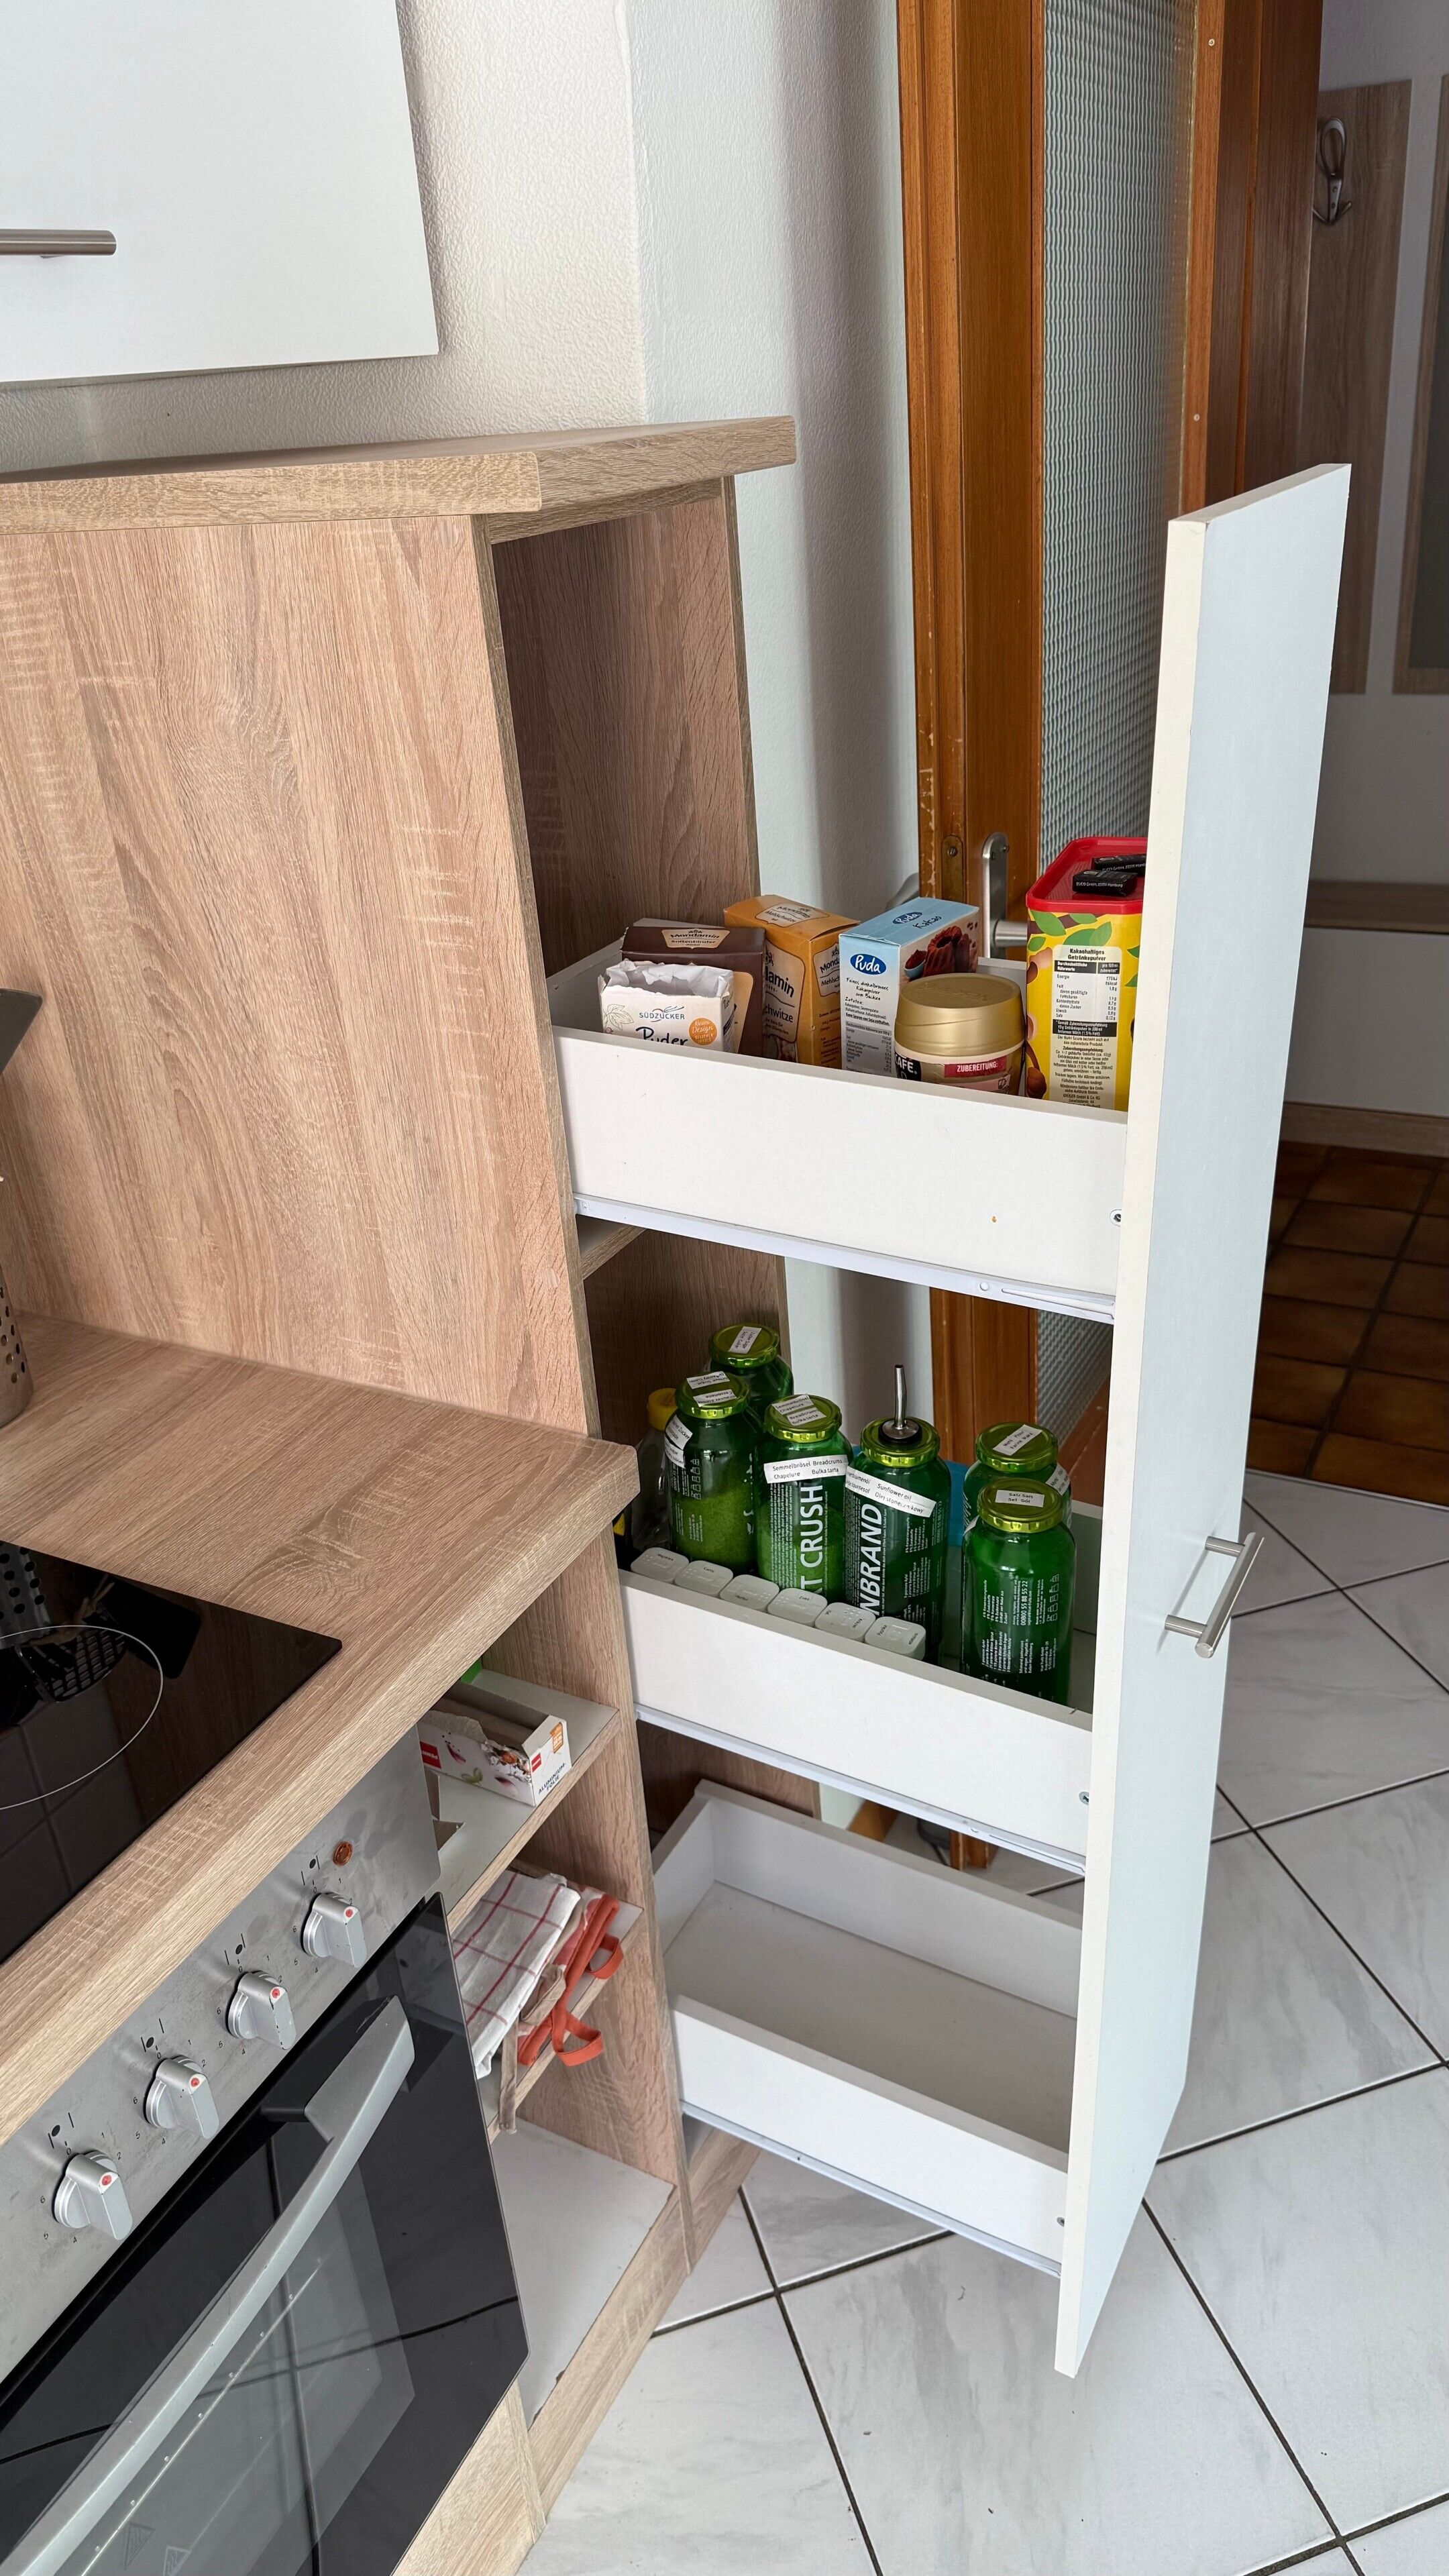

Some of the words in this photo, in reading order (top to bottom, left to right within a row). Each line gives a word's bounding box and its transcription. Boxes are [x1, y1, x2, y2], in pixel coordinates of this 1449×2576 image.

[896, 914, 918, 923] Puda
[913, 916, 942, 928] Kakao
[855, 955, 881, 973] Puda
[639, 1012, 684, 1020] SÜDZUCKER
[692, 1026, 714, 1034] Design
[957, 1061, 998, 1073] ZUBEREITUNG:
[773, 1461, 810, 1471] Semmelbrösel
[877, 1484, 903, 1497] Sunflower
[875, 1492, 885, 1500] Olej
[800, 1485, 823, 1568] CRUSH
[547, 1774, 559, 1791] FOLIE
[278, 1976, 282, 1984] 2
[201, 2059, 206, 2068] 2
[117, 2152, 121, 2160] 2
[40, 2196, 46, 2204] 6
